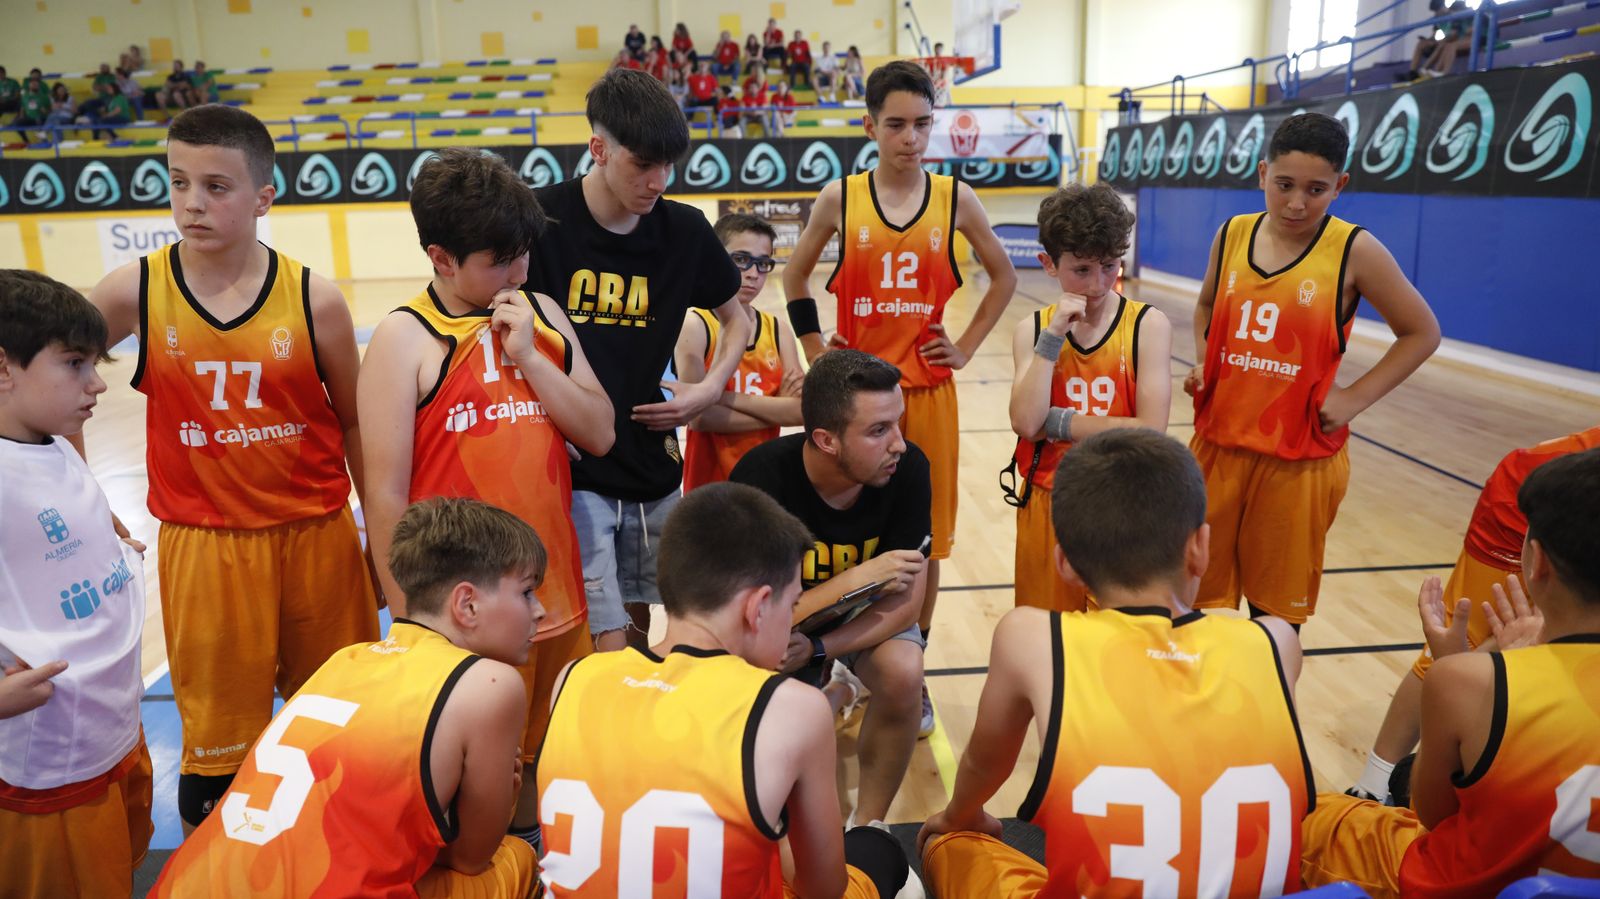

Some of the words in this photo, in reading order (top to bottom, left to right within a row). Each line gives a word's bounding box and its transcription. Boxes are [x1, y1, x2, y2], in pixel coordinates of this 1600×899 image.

[111, 224, 179, 251] Sum
[881, 251, 919, 289] 12
[567, 268, 649, 327] CBA
[1234, 299, 1280, 343] 19
[478, 329, 524, 383] 1
[1227, 351, 1302, 377] cajamar
[194, 361, 263, 410] 77
[732, 369, 764, 397] 16
[1065, 376, 1116, 417] 99
[213, 422, 308, 448] cajamar
[206, 742, 248, 757] cajamar
[221, 694, 361, 846] 5
[538, 778, 724, 899] 20
[1072, 763, 1292, 899] 30
